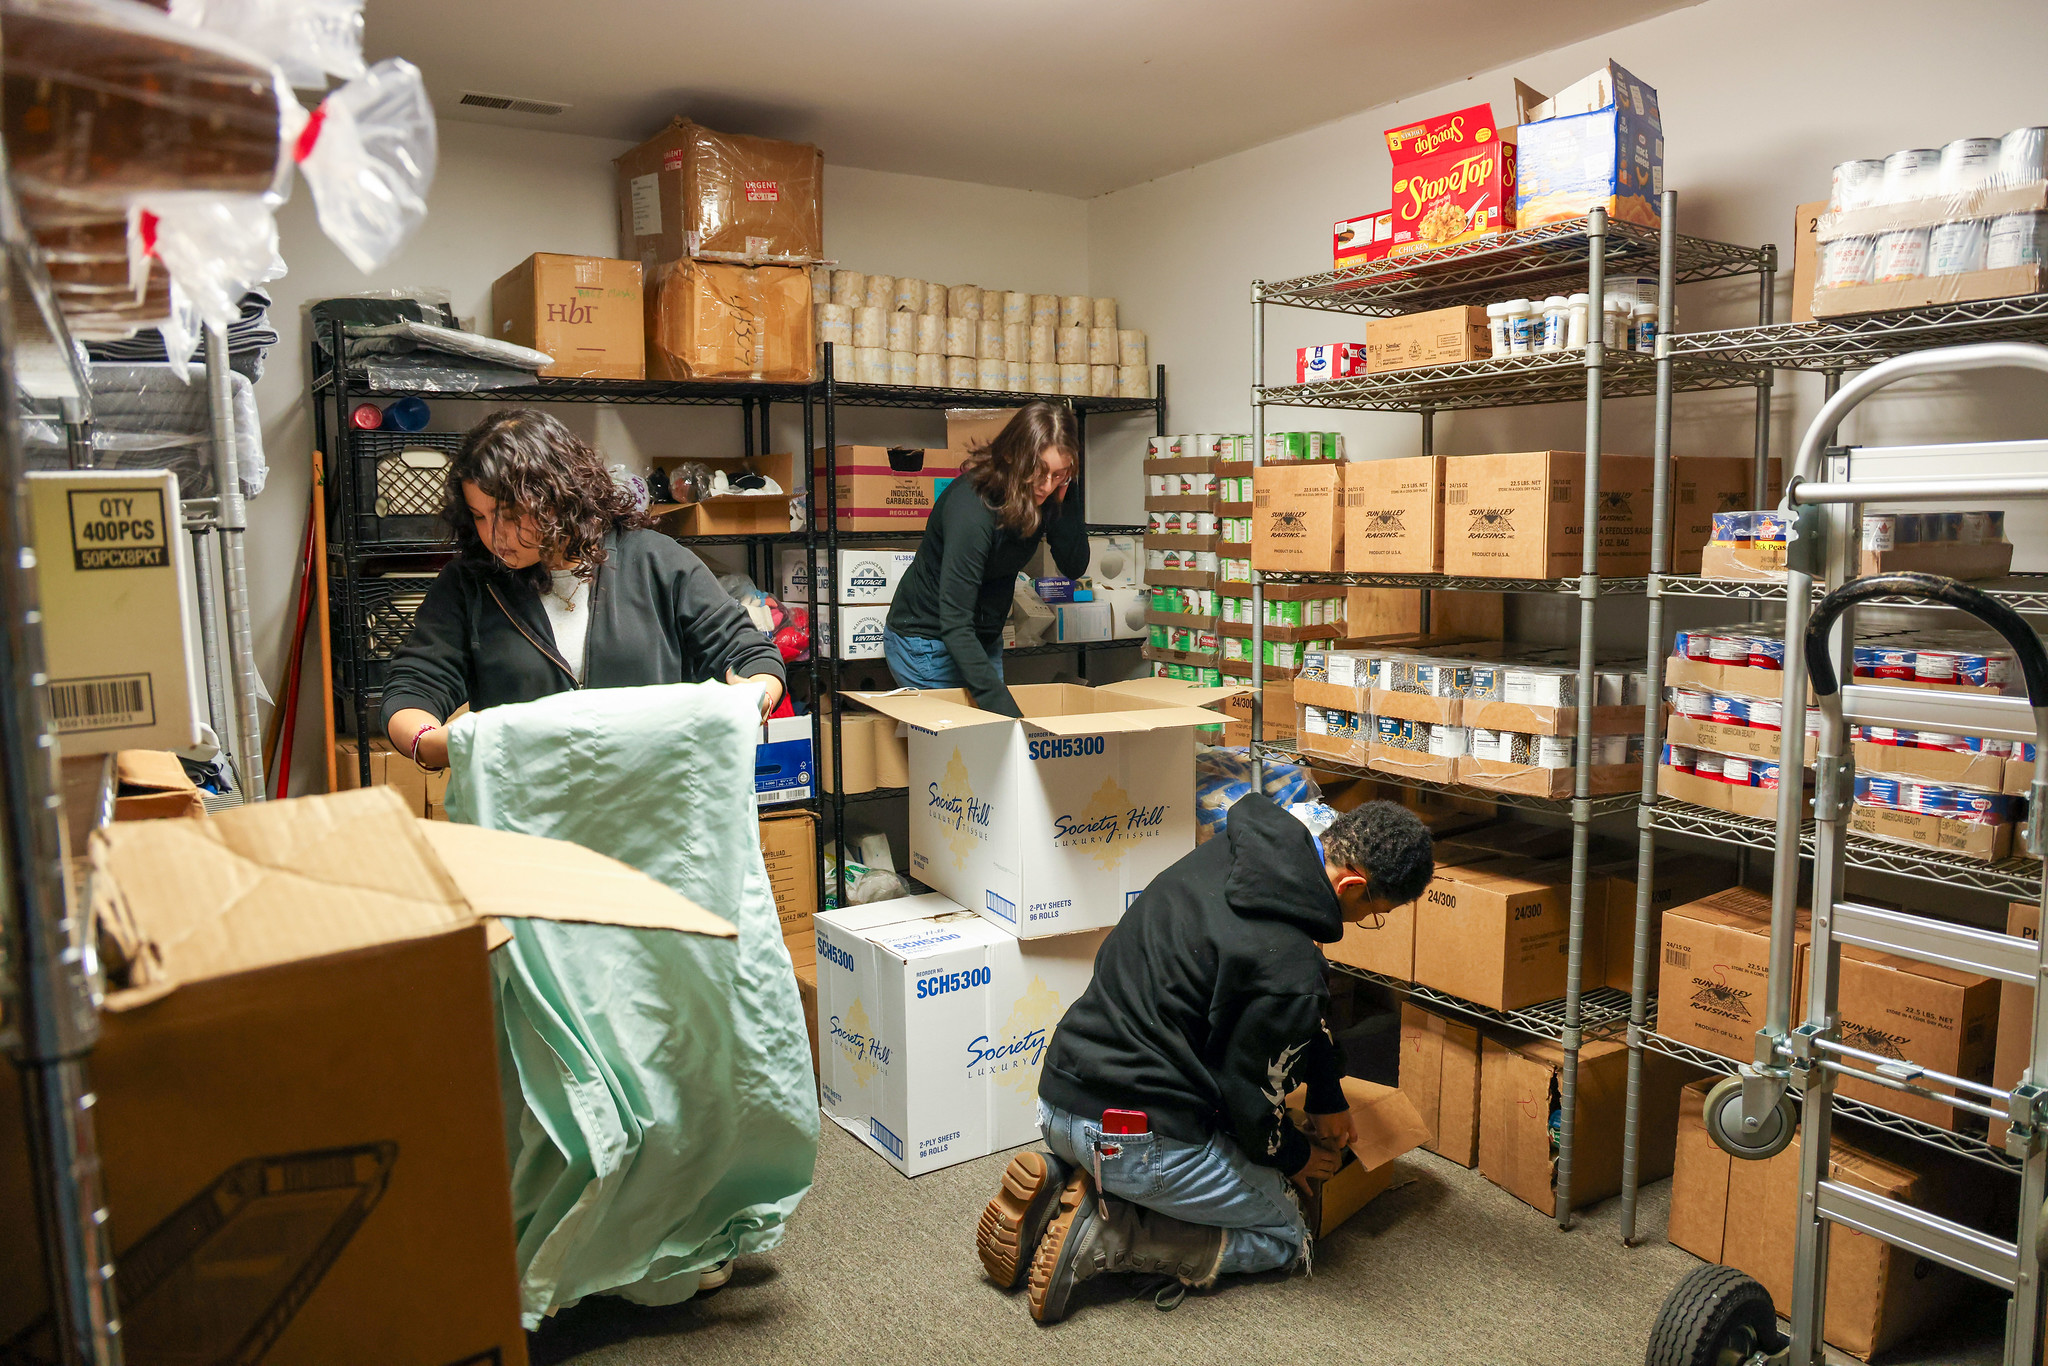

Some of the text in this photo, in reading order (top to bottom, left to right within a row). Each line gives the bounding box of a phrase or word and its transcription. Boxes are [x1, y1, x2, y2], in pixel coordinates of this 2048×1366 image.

[1478, 214, 1483, 223] 6
[1398, 242, 1429, 254] CHICKEN
[886, 497, 929, 506] GARBAGE BAGS
[890, 490, 924, 498] INDUSTRIAL
[100, 498, 133, 518] QTY
[1366, 510, 1380, 518] SUN
[1468, 508, 1484, 516] SUN
[83, 520, 154, 542] 400PCS
[1605, 526, 1633, 534] SEEDLESS
[1691, 525, 1712, 534] CALIFO
[1616, 538, 1629, 546] BAG
[82, 548, 161, 568] 50PCX8PKT
[851, 560, 878, 574] MAINTENANCE
[853, 616, 880, 630] MAINTENANCE
[855, 634, 883, 642] VINTAGE
[1029, 736, 1105, 760] SCH5300
[928, 782, 990, 830] Society Hill
[929, 811, 988, 841] LUXURY TISSUE
[1054, 806, 1165, 843] Society Hill
[1882, 812, 1921, 826] AMERICAN BEAUTY
[1054, 830, 1159, 847] LUXURY TISSUE
[1029, 900, 1072, 912] 2-PLY SHEETS
[1428, 889, 1456, 909] 24/300
[1039, 910, 1059, 920] ROLLS
[1515, 903, 1542, 920] 24/300
[893, 933, 961, 950] SCH5300
[1666, 942, 1682, 950] 24/15
[817, 937, 854, 972] SCH5300
[916, 969, 936, 977] REORDER
[917, 966, 991, 999] SCH5300
[1691, 977, 1752, 998] SUN VALLEY
[1690, 1002, 1740, 1021] RAISINS.
[1886, 1008, 1901, 1016] STORE
[1938, 1022, 1953, 1030] PLACE
[1905, 1006, 1953, 1024] 22.5 LBS. NET
[830, 1016, 890, 1065] Society Hill
[1695, 1022, 1719, 1034] PRODUCT
[1728, 1033, 1744, 1042] U.S.A.
[1840, 1020, 1911, 1045] SUN VALLEY
[967, 1028, 1048, 1065] Society
[968, 1058, 1028, 1078] LUXURY
[919, 1131, 960, 1150] 2-PLY SHEETS
[919, 1144, 948, 1158] 96 ROLLS
